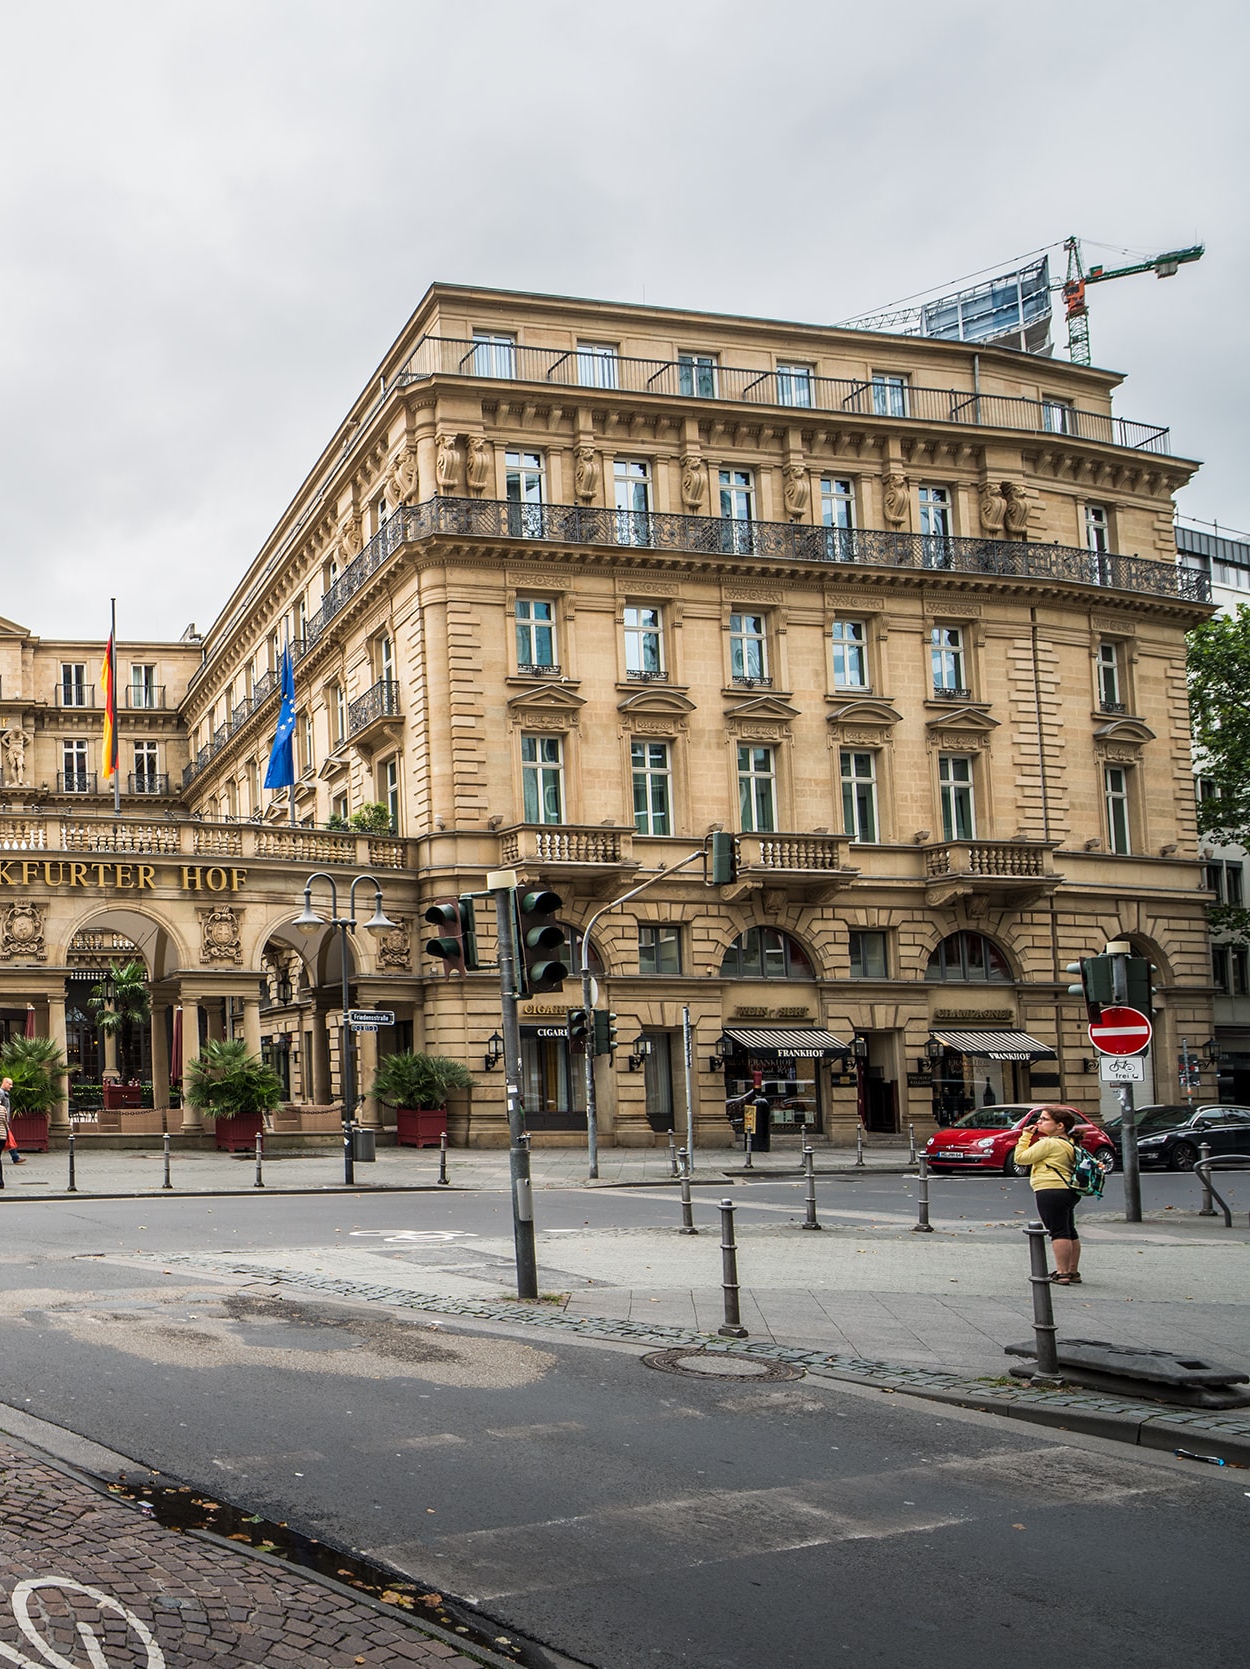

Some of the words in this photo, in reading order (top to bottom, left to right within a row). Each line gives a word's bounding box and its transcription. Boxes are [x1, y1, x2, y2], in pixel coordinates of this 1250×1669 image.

[180, 866, 248, 892] HOF
[353, 1013, 389, 1021] Friedensstraße
[777, 1049, 824, 1057] FRANKHOF
